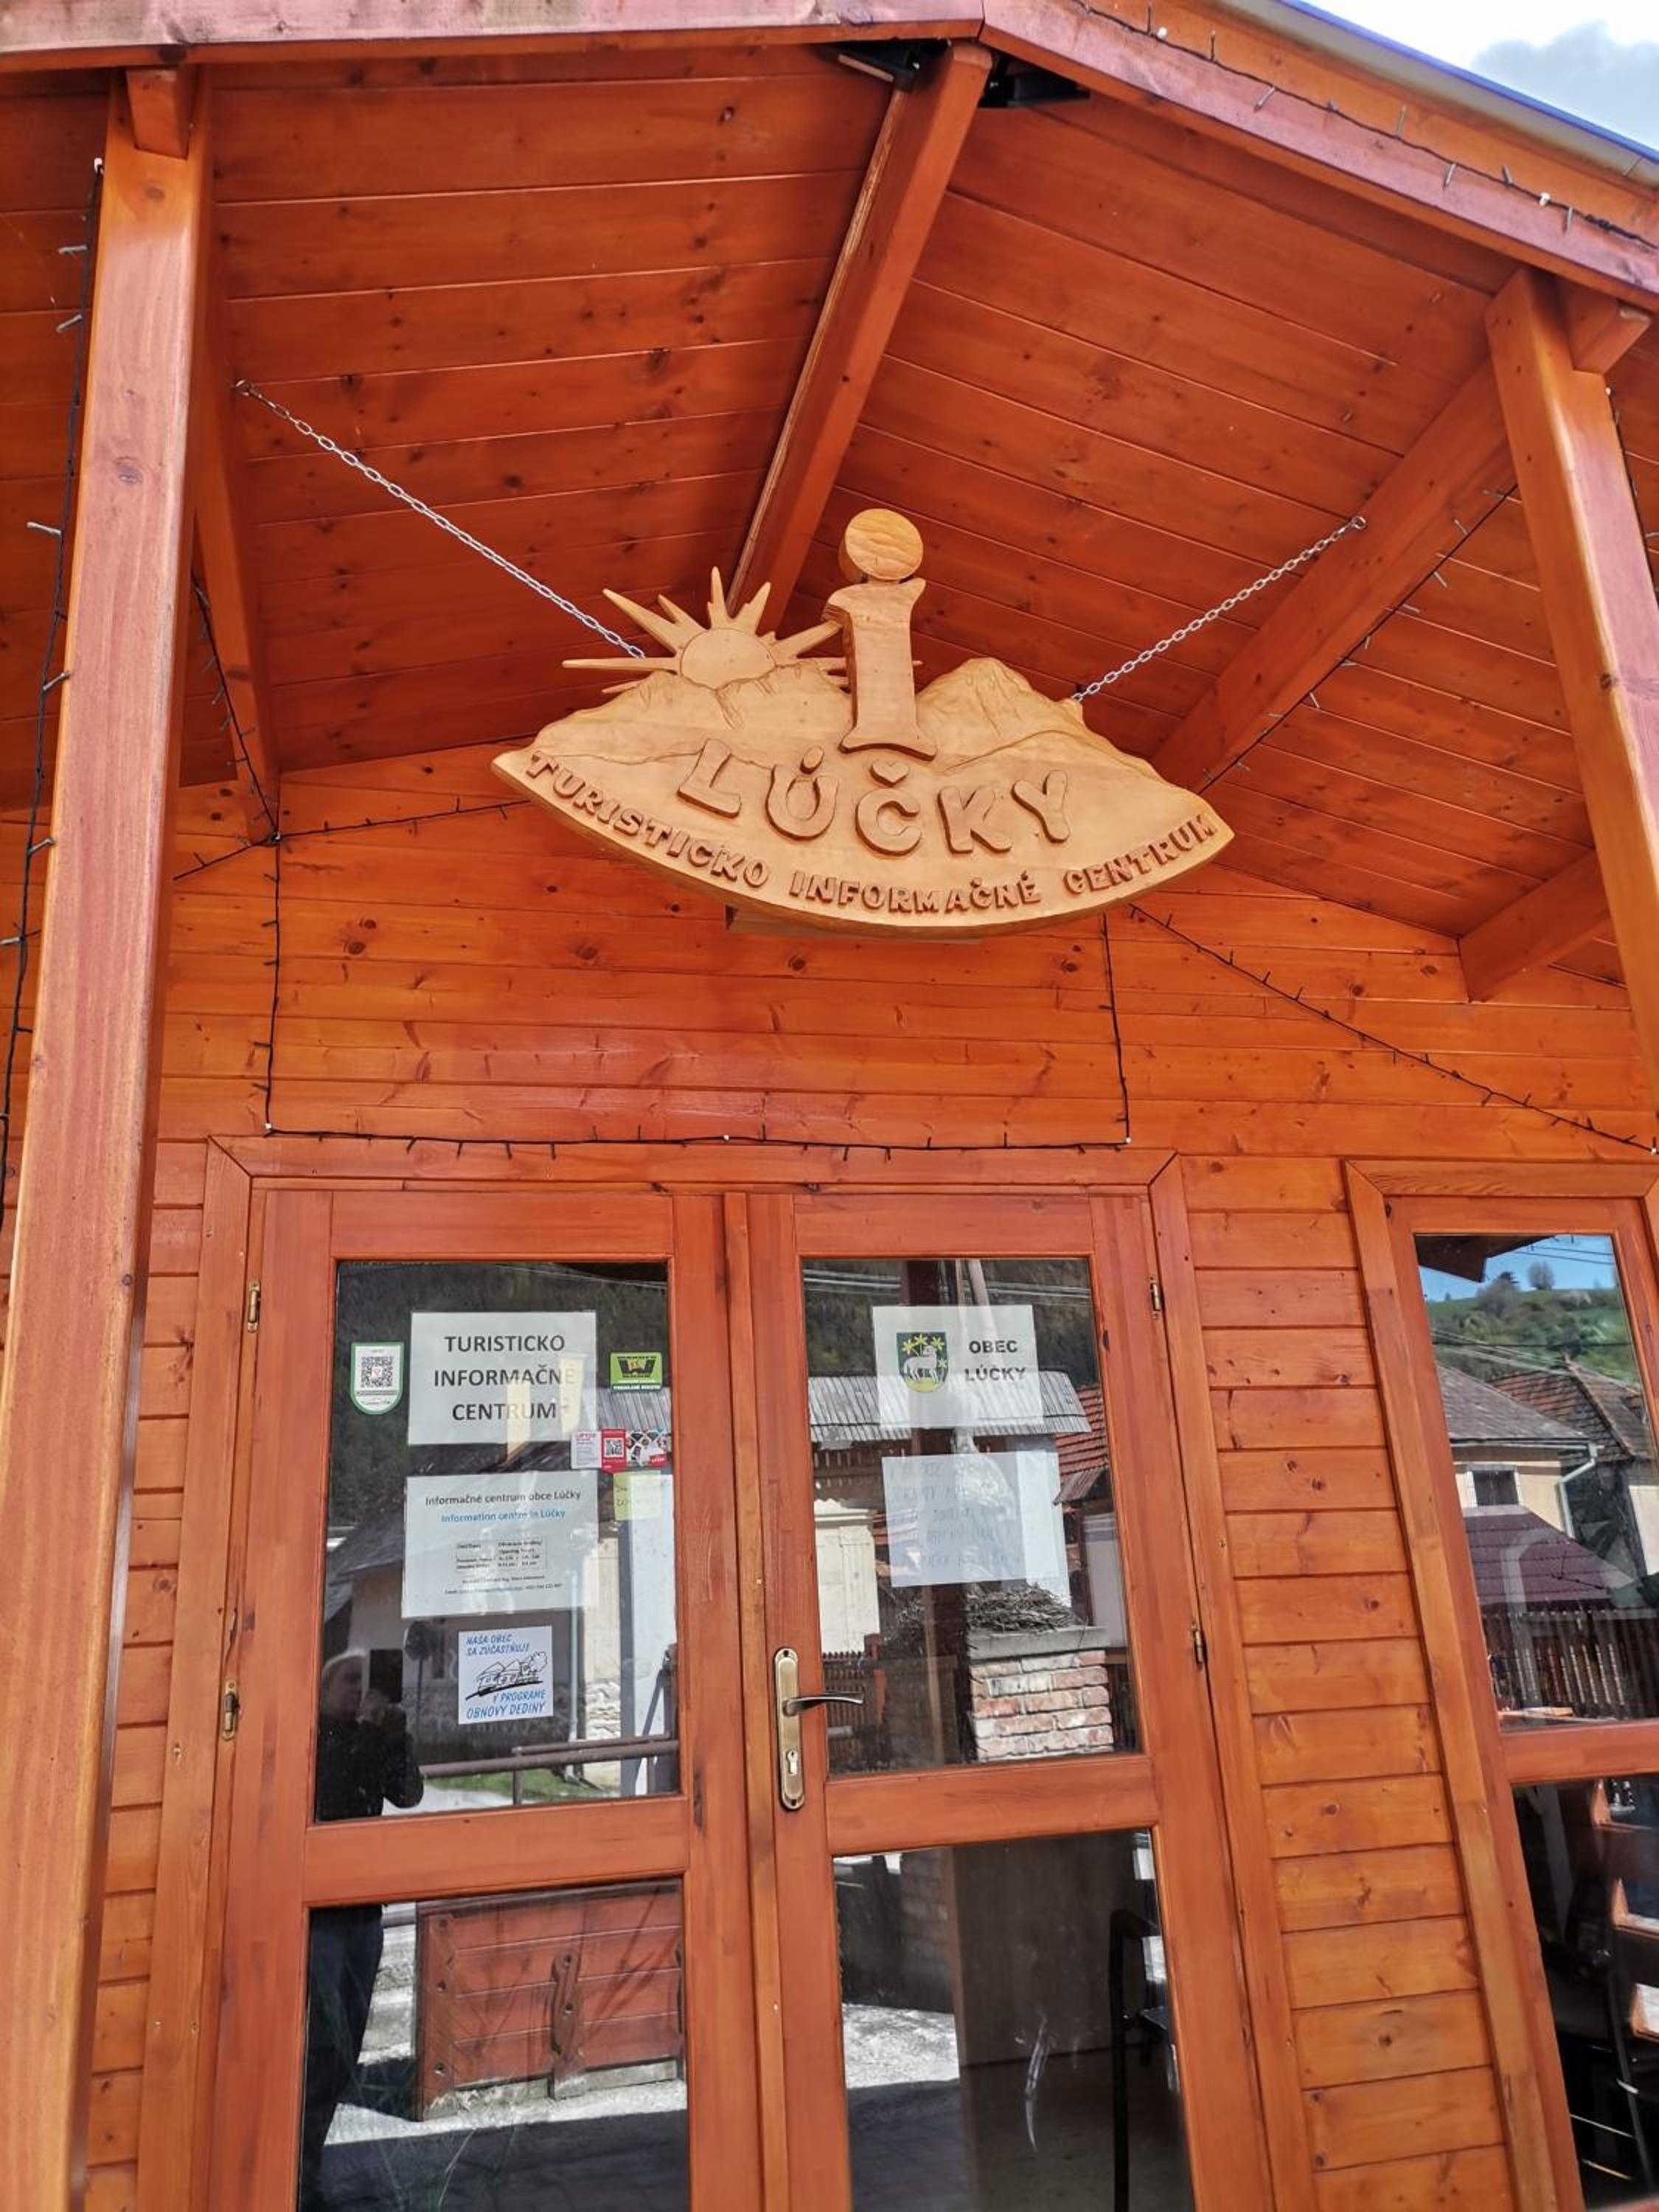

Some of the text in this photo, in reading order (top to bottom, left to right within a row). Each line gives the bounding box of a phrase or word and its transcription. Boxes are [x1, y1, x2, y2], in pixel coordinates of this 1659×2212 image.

[678, 737, 1071, 857] LÚČKY
[525, 751, 1219, 914] TURISTICKO INFORMAČNÉ CENTRUM
[445, 1335, 566, 1352] TURISTICKO
[968, 1340, 1018, 1354] OBEC
[434, 1364, 579, 1387] INFORMAČNÉ
[964, 1364, 1027, 1382] LÚČKY
[452, 1402, 557, 1421] CENTRUM
[425, 1489, 581, 1506] Informačné centrum obce Lúčky
[442, 1513, 496, 1523] Information
[466, 1635, 488, 1645] NAŠA
[466, 1699, 546, 1719] OBNOVY DEDINY
